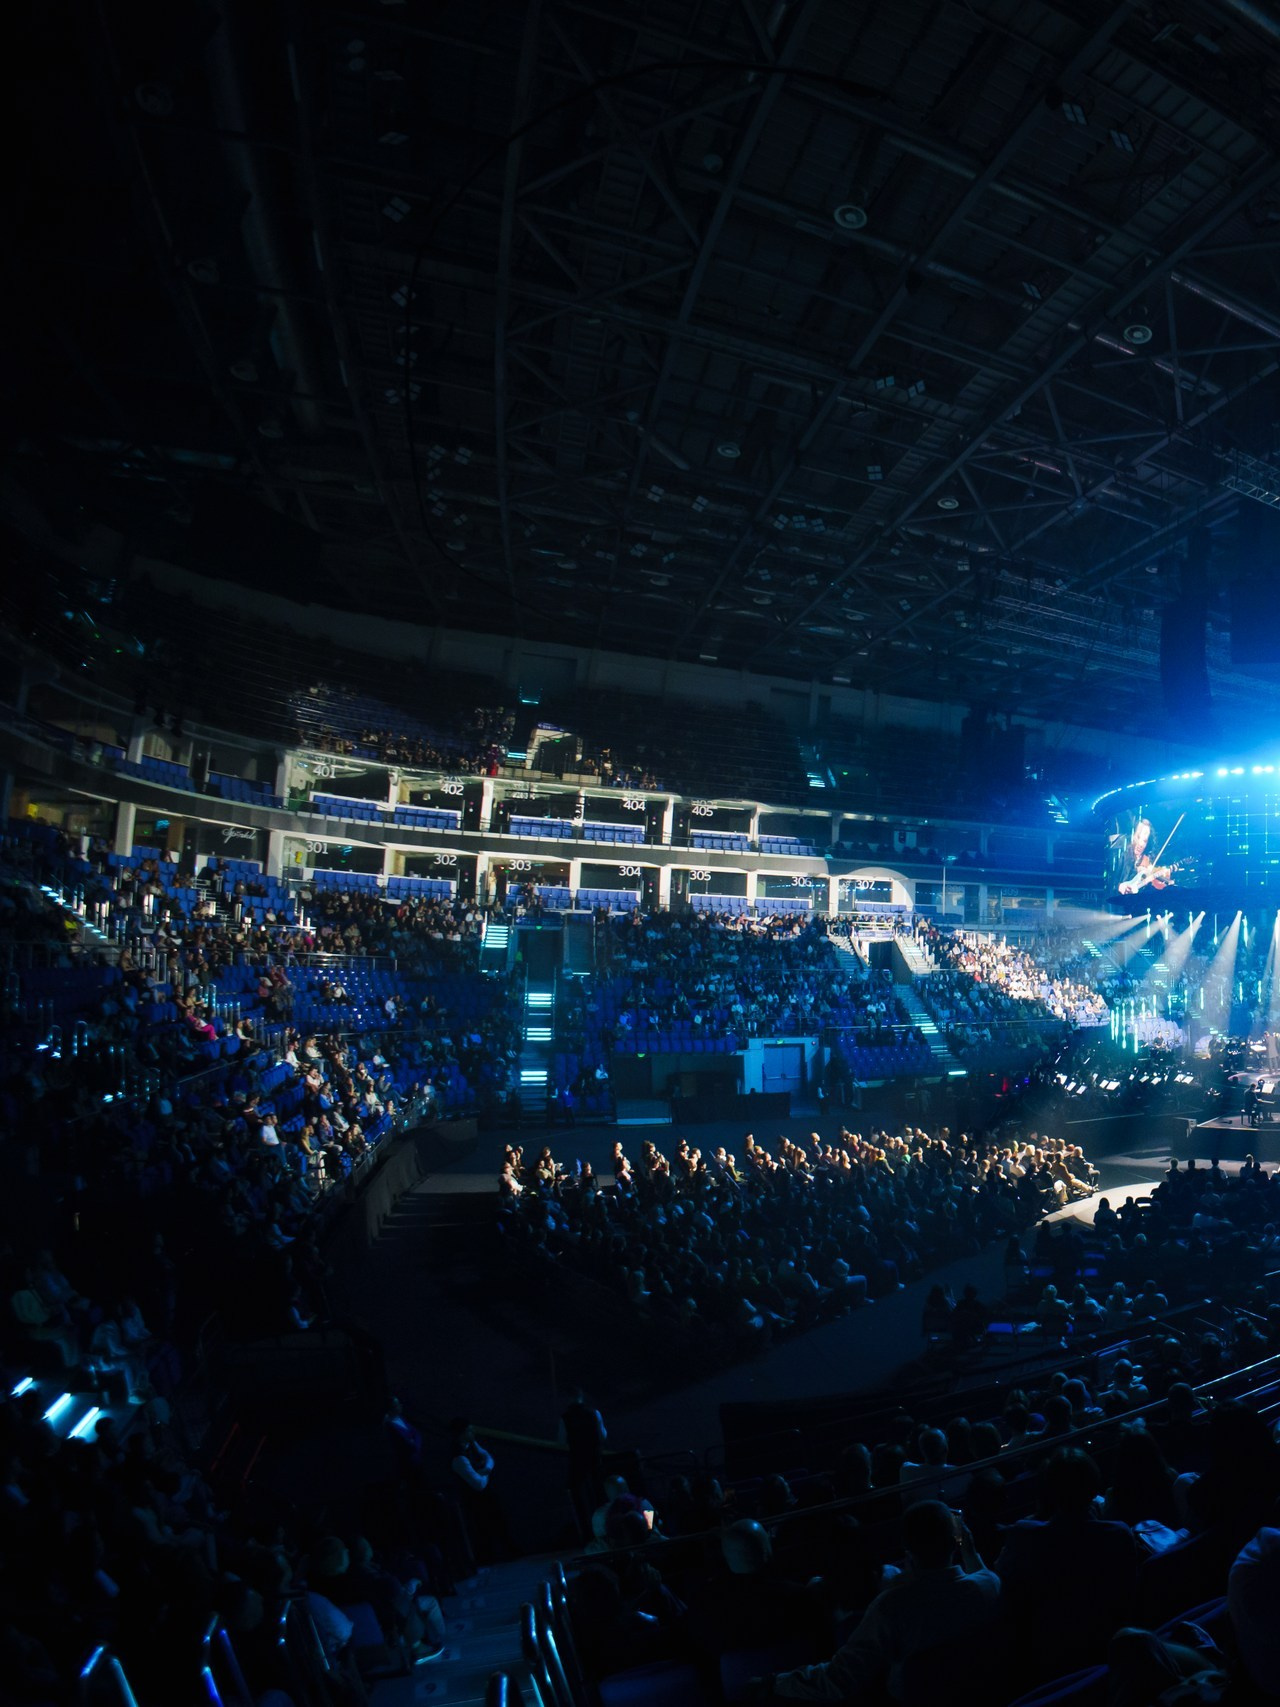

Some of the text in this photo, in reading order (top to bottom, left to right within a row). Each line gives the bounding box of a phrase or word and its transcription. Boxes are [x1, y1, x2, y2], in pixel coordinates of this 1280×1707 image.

[313, 765, 336, 779] 401
[441, 783, 464, 796] 402
[623, 800, 646, 811] 404
[691, 806, 714, 817] 405
[305, 841, 328, 854] 301
[433, 854, 457, 866] 302
[508, 860, 532, 871] 303
[618, 866, 641, 877] 304
[690, 870, 711, 881] 305
[791, 876, 812, 887] 306
[856, 880, 875, 890] 307
